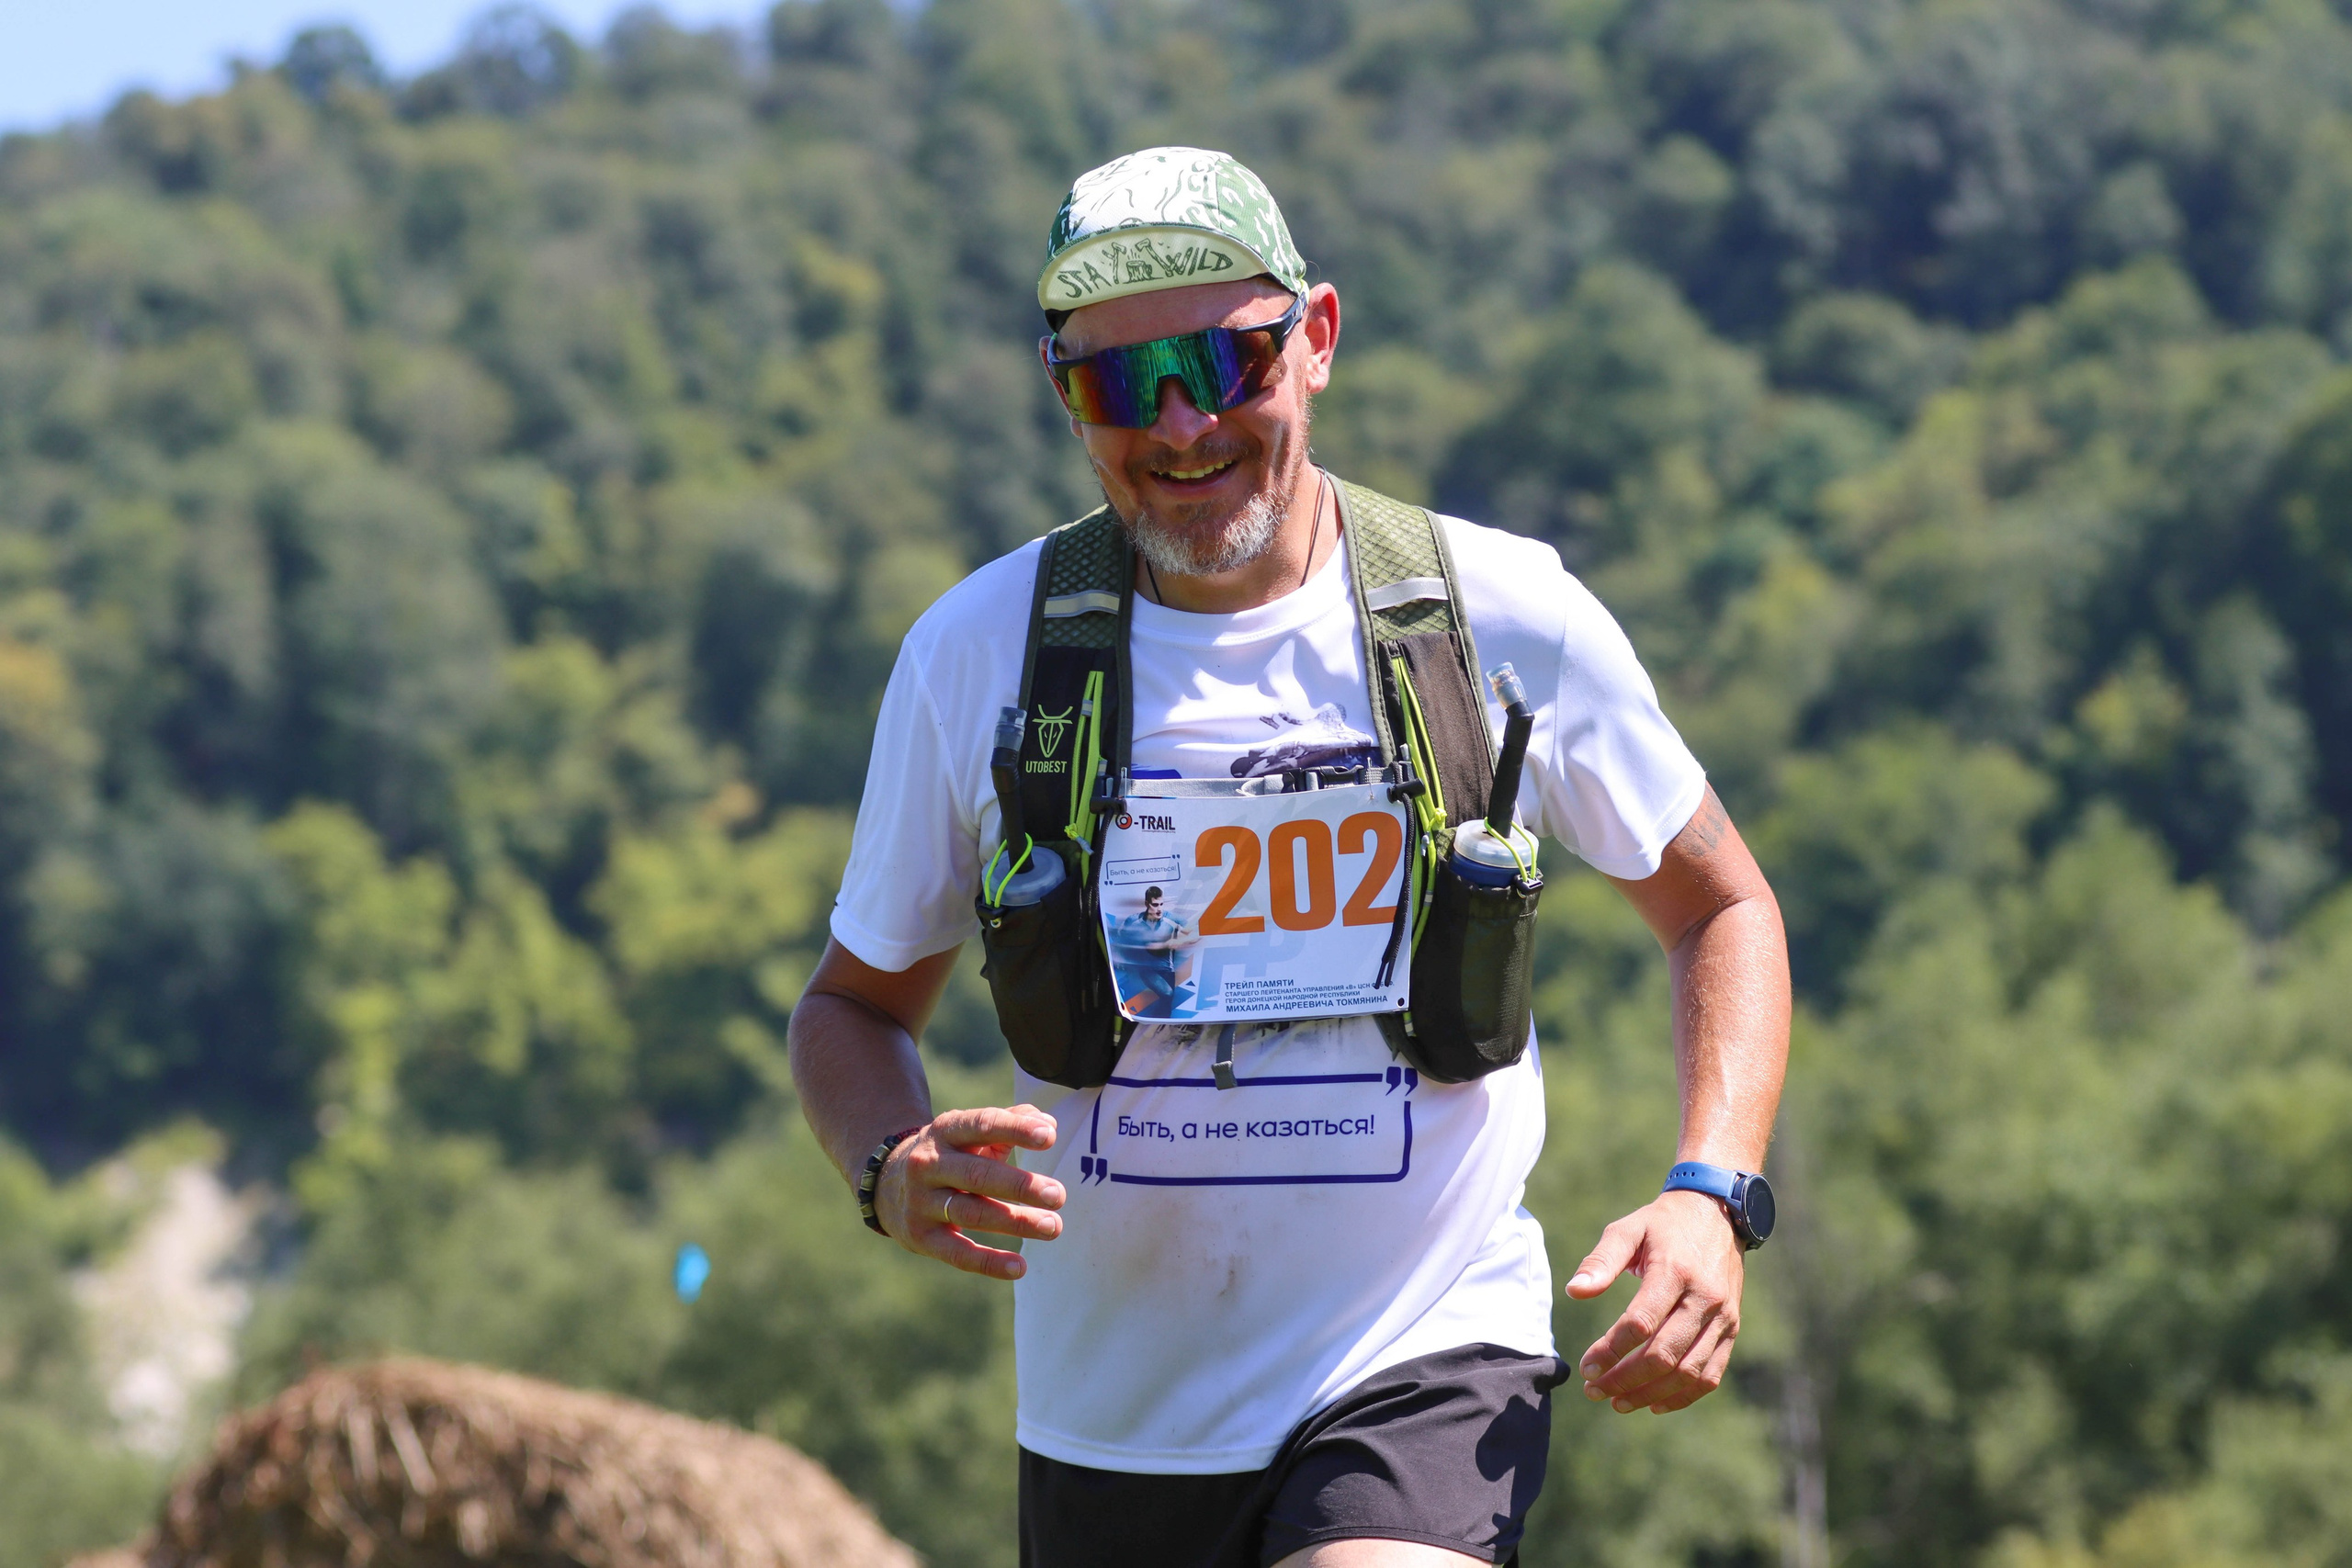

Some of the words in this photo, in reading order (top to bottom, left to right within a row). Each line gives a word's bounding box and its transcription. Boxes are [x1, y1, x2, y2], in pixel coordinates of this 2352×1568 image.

[1025, 761, 1068, 773] UTOBEST
[1194, 810, 1403, 937] 202
[1225, 981, 1254, 990] ТРЕЙЛ
[1256, 979, 1295, 988] ПАМЯТИ
[1226, 1003, 1271, 1012] МИХАИЛА
[1272, 1000, 1334, 1010] АНДРЕЕВИЧА
[1336, 995, 1388, 1006] ТОКМЯНИНА
[1117, 1115, 1175, 1143] Быть,
[1181, 1122, 1198, 1139] а
[1205, 1122, 1238, 1139] не
[1245, 1114, 1375, 1138] казаться!
